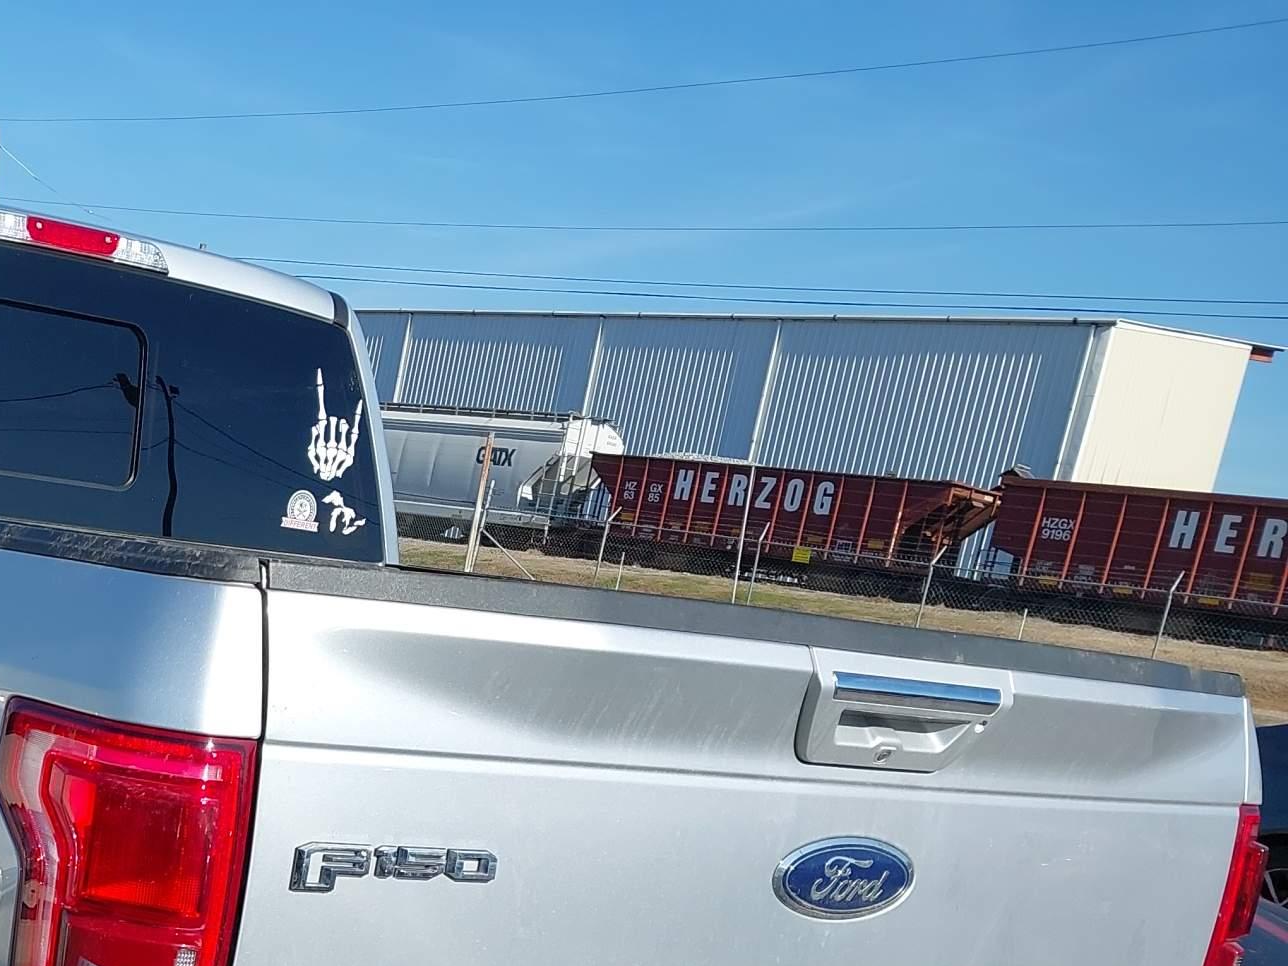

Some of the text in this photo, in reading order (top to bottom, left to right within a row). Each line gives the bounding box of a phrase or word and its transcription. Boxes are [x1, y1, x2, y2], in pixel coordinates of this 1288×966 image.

[476, 446, 517, 467] GATX
[673, 469, 835, 515] HERZOG
[1042, 517, 1076, 529] HZGX
[1042, 528, 1072, 541] 9196
[1168, 510, 1288, 559] HER
[810, 855, 890, 902] Ford
